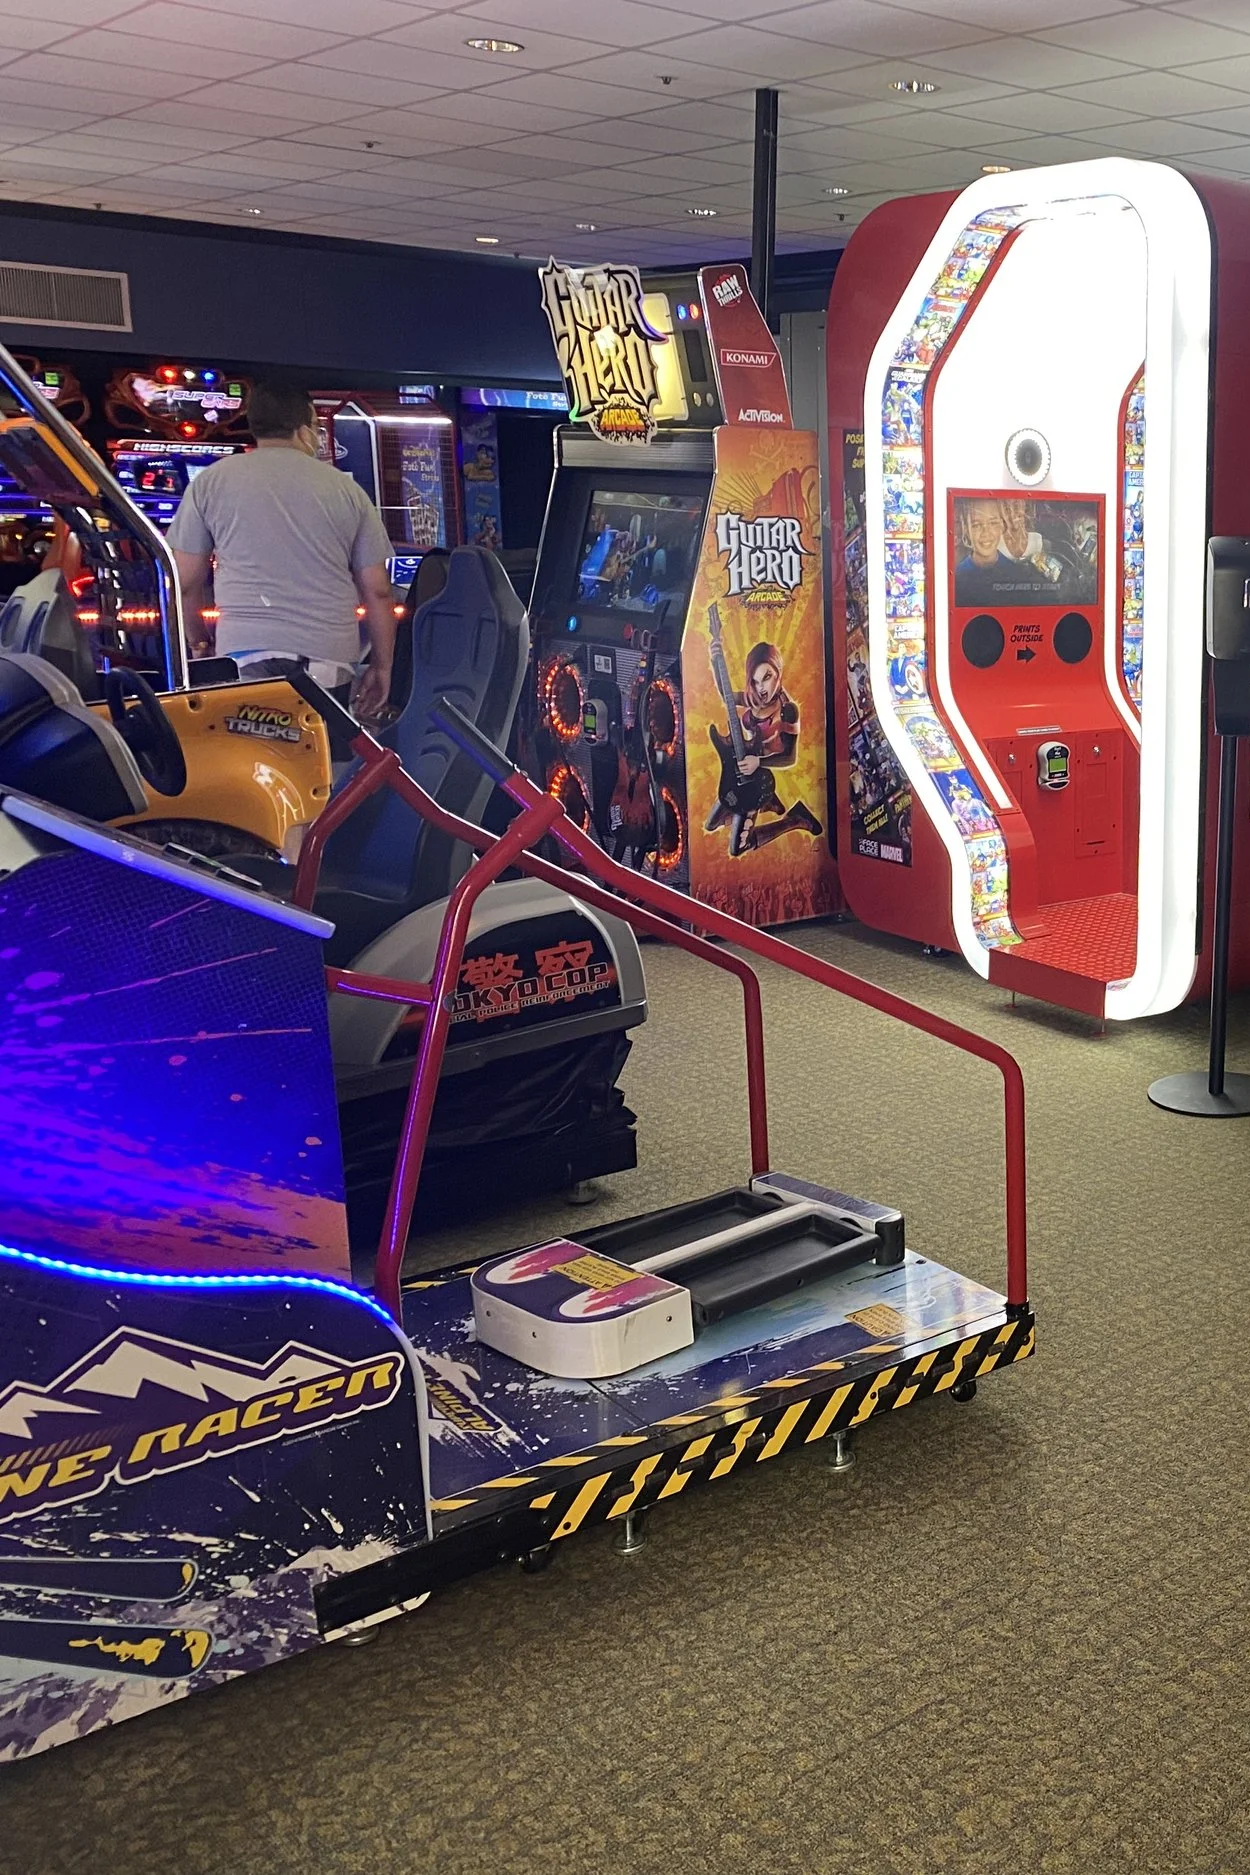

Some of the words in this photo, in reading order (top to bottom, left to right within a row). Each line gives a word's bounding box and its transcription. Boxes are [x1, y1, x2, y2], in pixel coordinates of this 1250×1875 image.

[712, 275, 739, 299] RAW
[718, 286, 743, 307] THRILLS
[569, 324, 657, 413] HERO
[726, 353, 768, 365] KONAMI
[172, 391, 226, 400] SUPER
[600, 409, 645, 431] ARCADE
[738, 408, 784, 423] ACTIVISION
[716, 512, 808, 562] GUITAR
[728, 544, 802, 596] HERO
[746, 591, 786, 602] ARCADE
[1010, 634, 1044, 643] OUTSIDE
[1013, 624, 1041, 634] PRINTS
[239, 706, 292, 726] NITRO
[225, 717, 300, 741] TRUCKS
[863, 804, 885, 825] COLLECT
[859, 845, 879, 856] PLACE
[862, 838, 879, 848] FACE
[880, 844, 903, 863] MARVEL
[544, 961, 609, 991] COP
[127, 1361, 394, 1464] RACER
[426, 1382, 496, 1432] ALPINE
